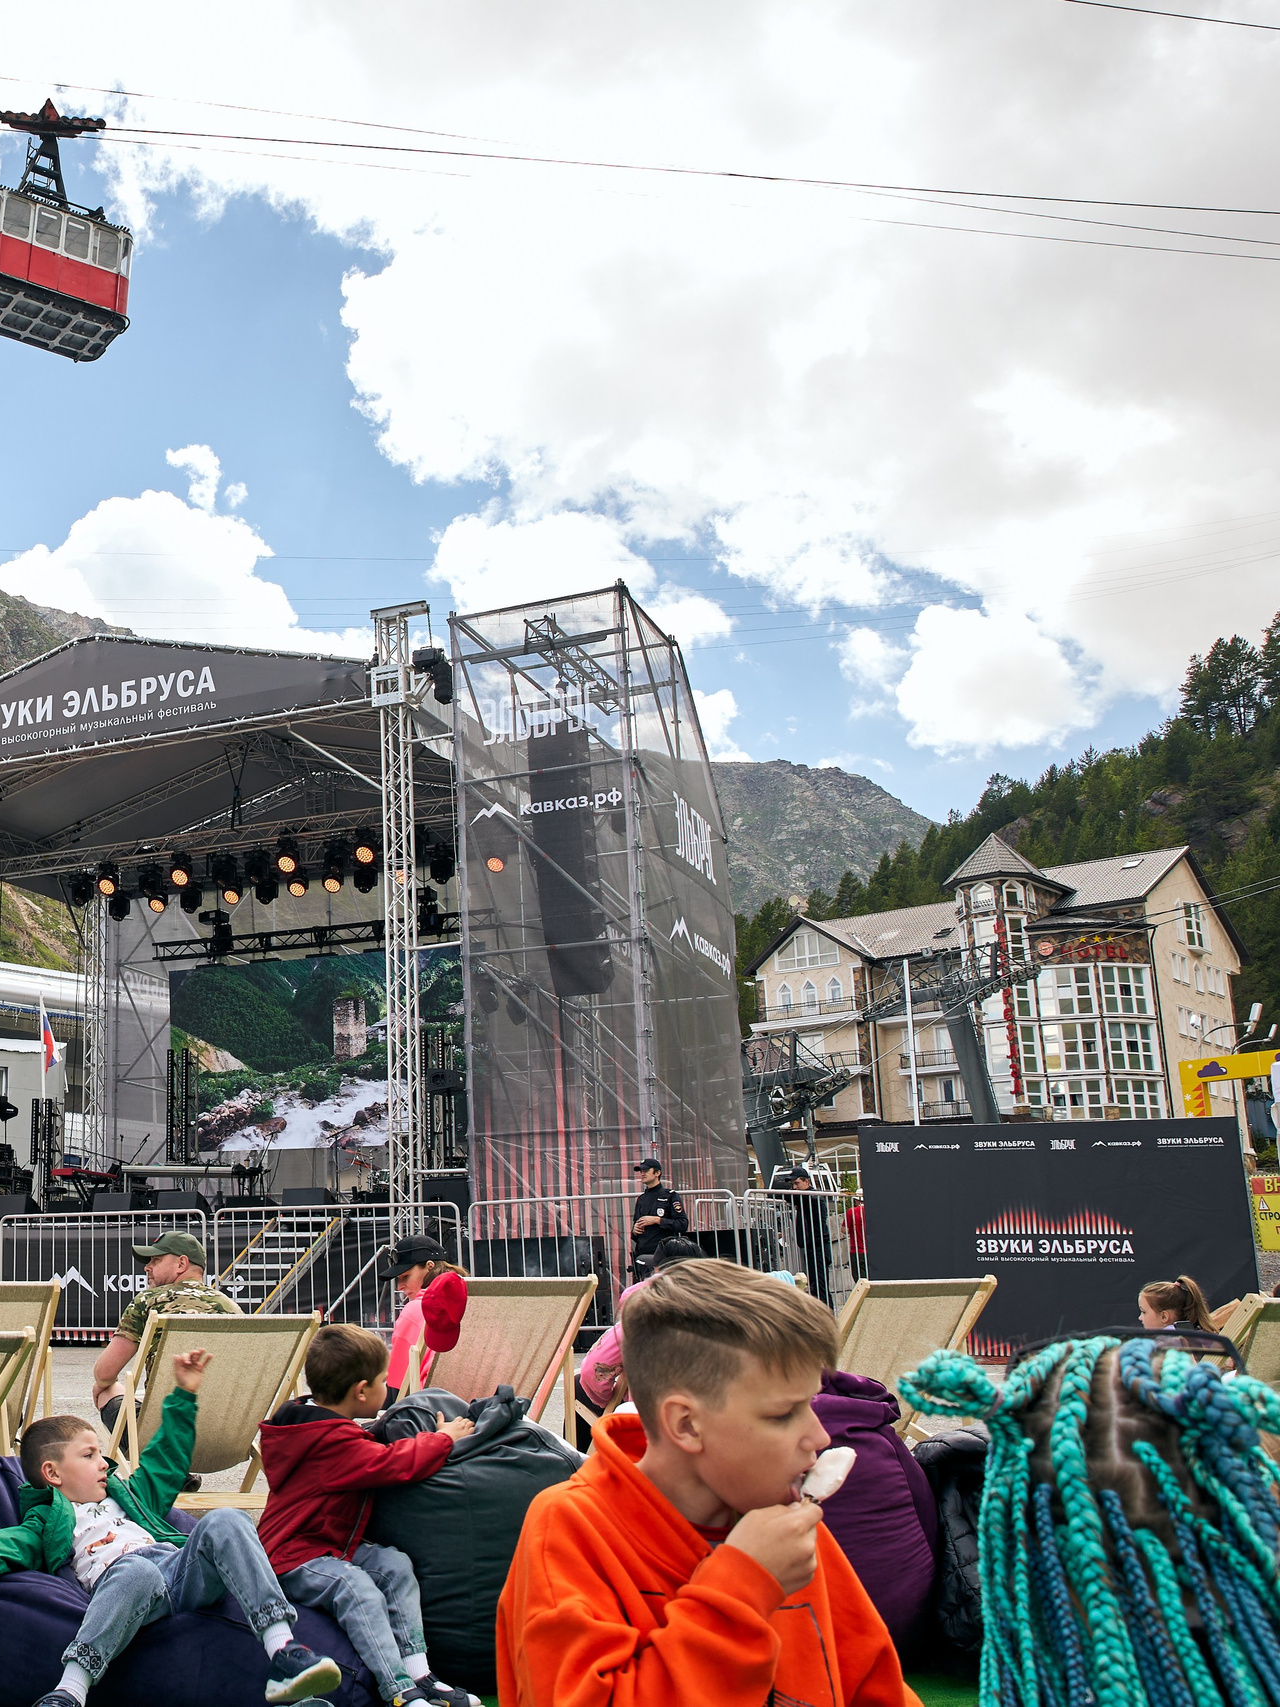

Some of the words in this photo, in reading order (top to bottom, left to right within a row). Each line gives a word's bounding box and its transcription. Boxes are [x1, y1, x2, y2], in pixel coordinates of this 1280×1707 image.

[62, 666, 216, 718] ЭЛЬБРУСА
[1, 722, 76, 745] высокогорный
[80, 709, 154, 733] музыкальный
[157, 701, 217, 720] фестиваль
[520, 787, 623, 816] кавказ.рф
[673, 790, 717, 886] ЭЛЬБРУС
[694, 932, 731, 981] кавказ.рф
[1061, 945, 1129, 959] HOTEL
[928, 1143, 961, 1151] кавказ.рф
[998, 1140, 1036, 1148] ЭЛЬБРУСА
[976, 1239, 1034, 1254] ЗВУКИ
[1038, 1239, 1134, 1254] ЭЛЬБРУСА
